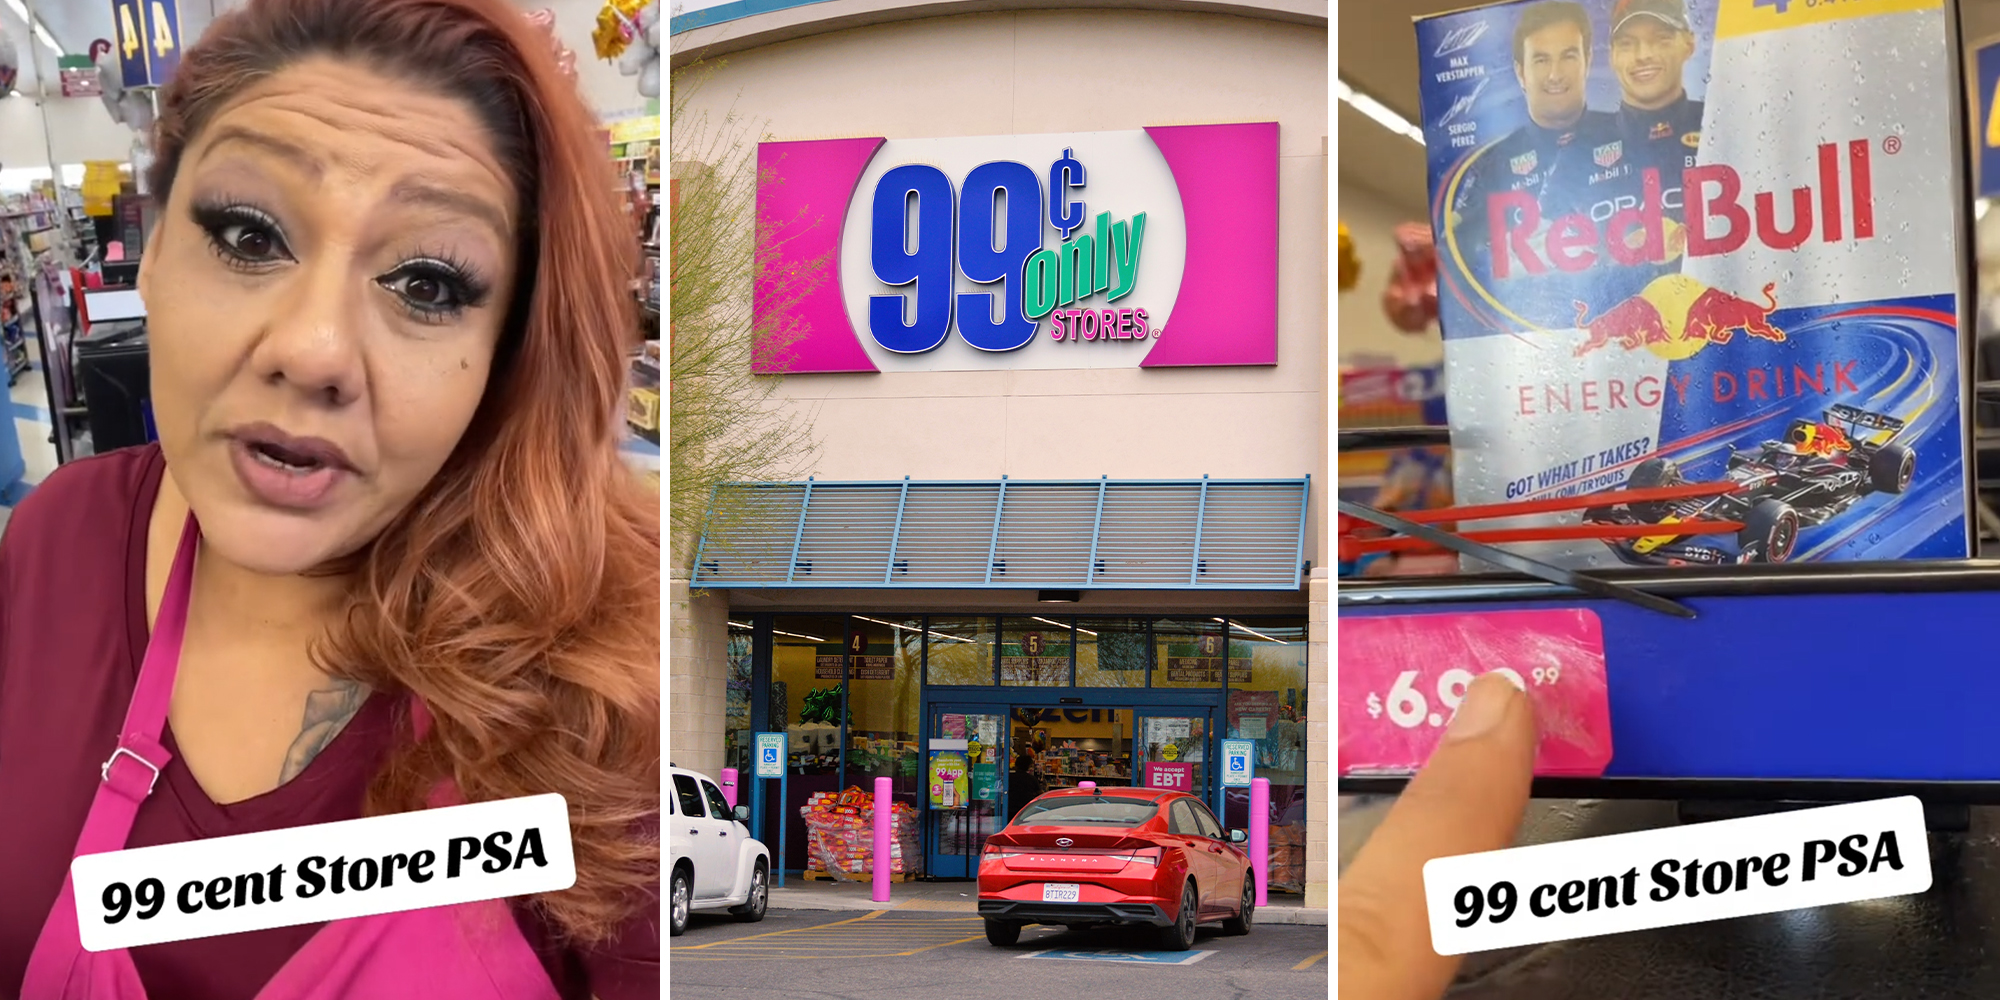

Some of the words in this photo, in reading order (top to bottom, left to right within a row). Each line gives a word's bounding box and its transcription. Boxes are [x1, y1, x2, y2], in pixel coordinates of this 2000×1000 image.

[1450, 56, 1468, 68] MAX
[1436, 65, 1485, 83] VERSTAPPEN
[1448, 122, 1477, 135] SERGIO
[1486, 167, 1666, 281] Red
[1683, 139, 1874, 258] Bull
[1025, 210, 1147, 318] only
[1050, 308, 1150, 341] STORES
[1519, 373, 1692, 416] ENERGY
[1714, 360, 1858, 403] DRINK
[1506, 475, 1534, 498] GOT
[1538, 460, 1578, 488] WHAT
[1582, 455, 1595, 474] IT
[1600, 437, 1650, 469] TAKES?
[852, 635, 860, 651] 4
[1029, 636, 1038, 652] 5
[1206, 636, 1215, 653] 6
[1367, 667, 1526, 728] $6.9
[936, 768, 946, 776] 99
[947, 768, 963, 777] App
[1153, 772, 1184, 786] EBT
[1046, 890, 1076, 900] 8TIR229
